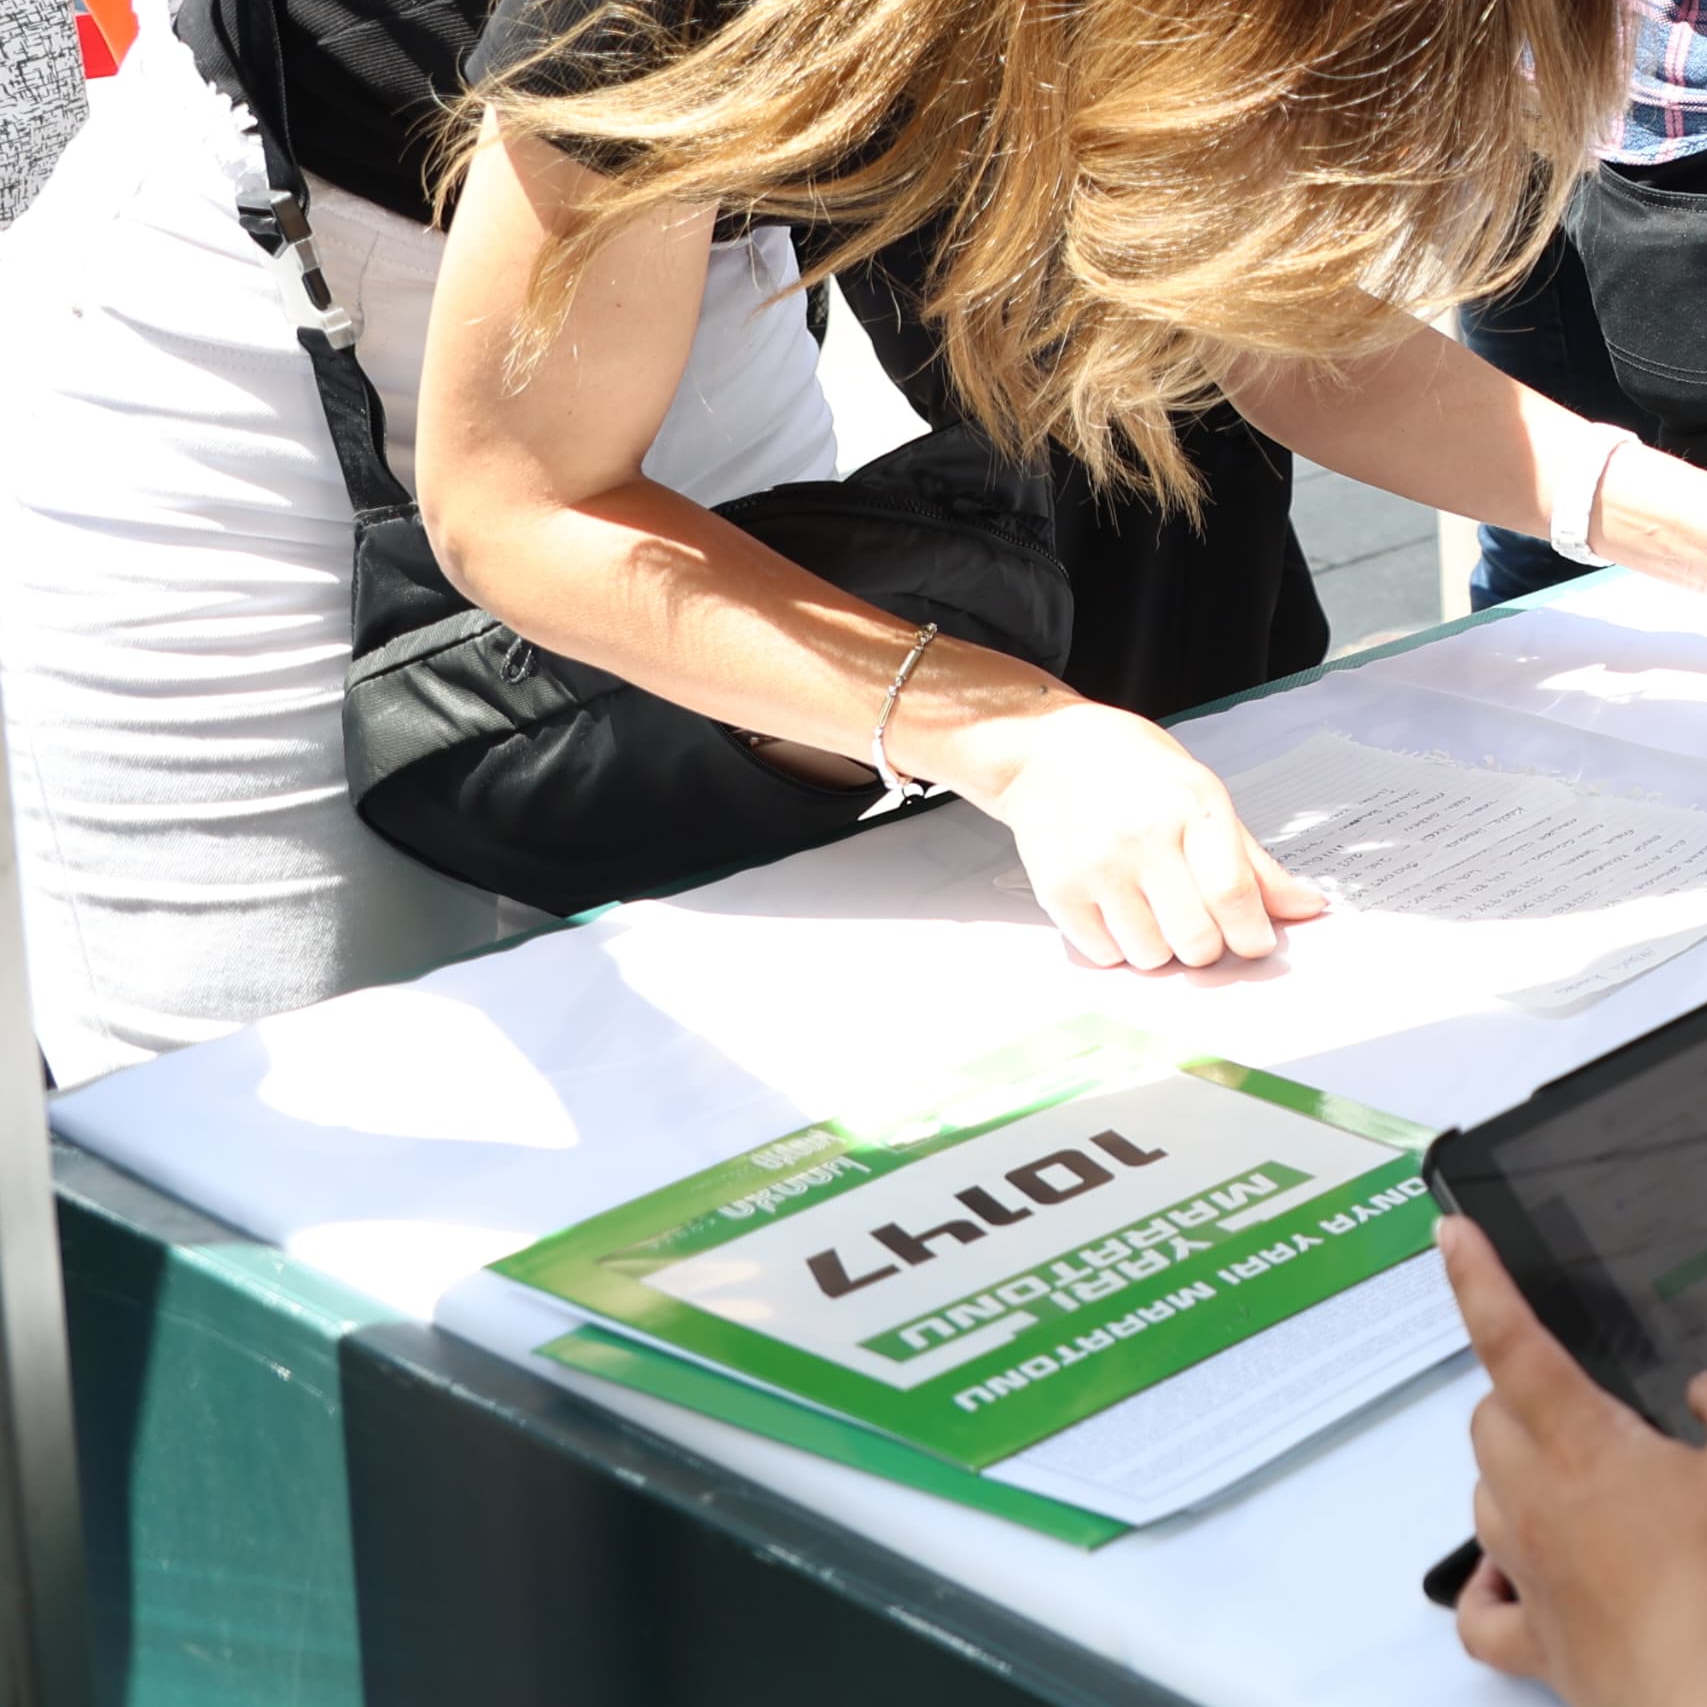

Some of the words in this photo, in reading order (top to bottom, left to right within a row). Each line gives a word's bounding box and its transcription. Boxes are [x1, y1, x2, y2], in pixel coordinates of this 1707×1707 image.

[803, 1126, 1168, 1299] 10147
[1220, 1226, 1325, 1287] YARI
[1318, 1175, 1429, 1235] ONYA
[900, 1171, 1281, 1352] MARATONU
[1053, 1232, 1214, 1314] YARI
[953, 1277, 1218, 1414] MARATONU
